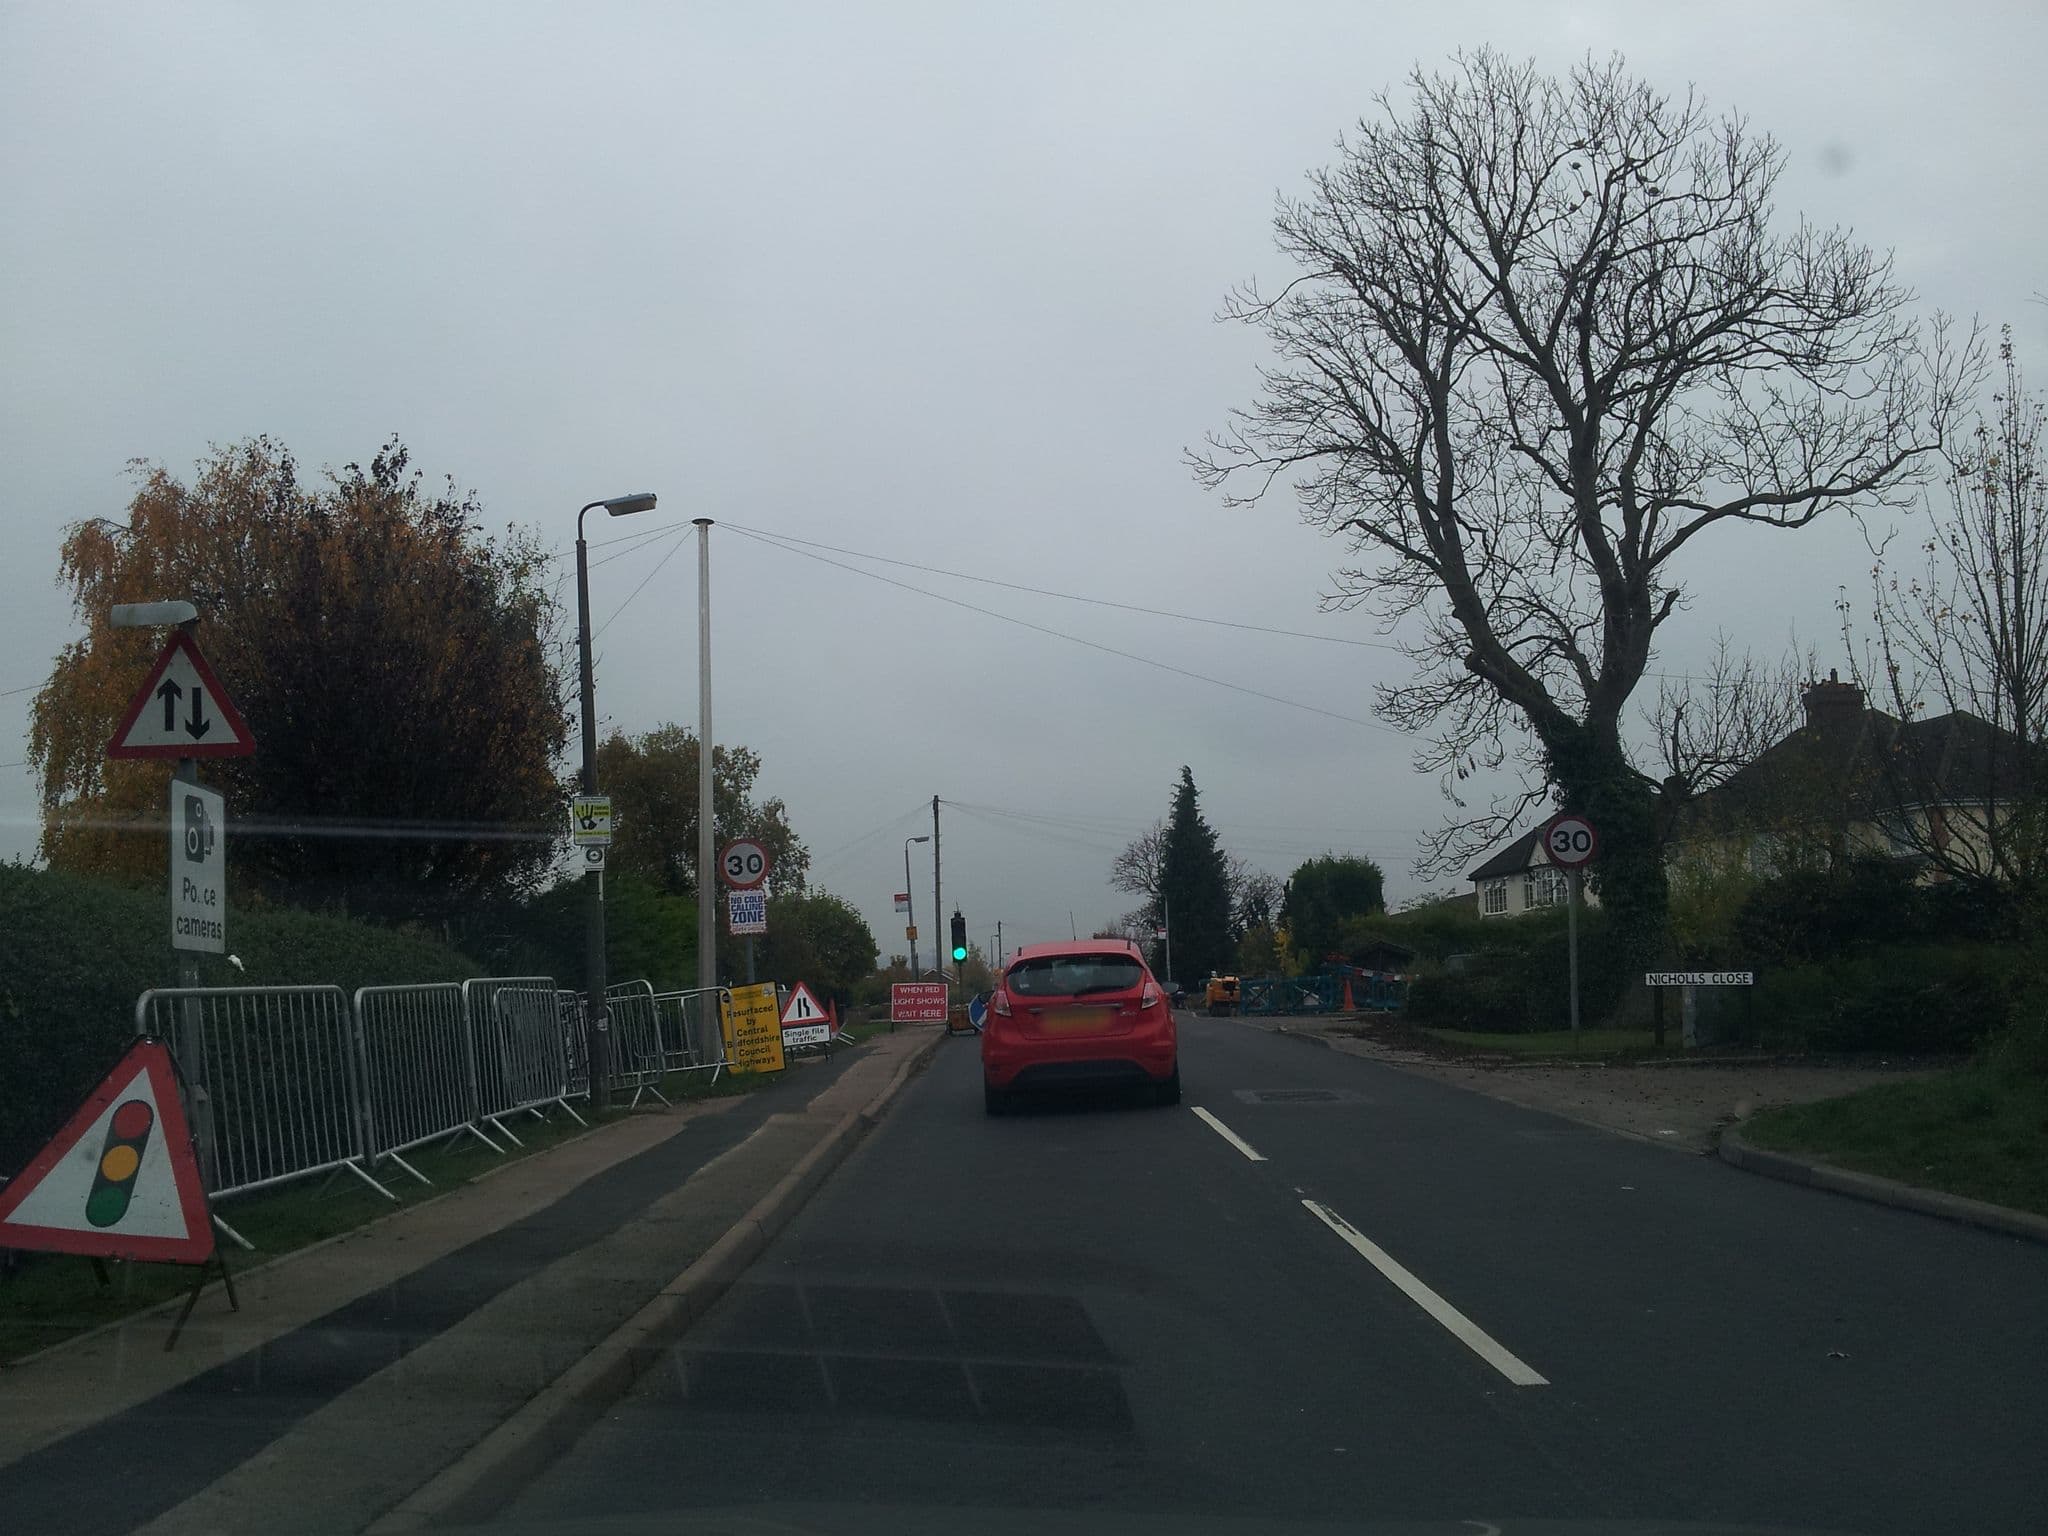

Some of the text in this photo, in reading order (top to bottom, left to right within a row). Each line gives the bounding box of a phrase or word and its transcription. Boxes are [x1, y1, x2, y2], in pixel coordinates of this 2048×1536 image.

[1553, 830, 1591, 852] 30
[728, 854, 763, 876] 30
[183, 877, 216, 906] Poce
[731, 903, 763, 912] CALLING
[732, 911, 764, 923] ZONE
[177, 916, 222, 939] cameras
[1649, 973, 1750, 985] NICHOLLS CLOSE
[916, 997, 945, 1005] SHOWS
[897, 1009, 942, 1018] WAIT HERE
[746, 1017, 757, 1026] by
[737, 1025, 768, 1037] Central
[784, 1027, 825, 1038] Single file
[727, 1034, 780, 1049] Bdfordshire
[792, 1035, 817, 1043] traffic
[739, 1045, 771, 1057] Council
